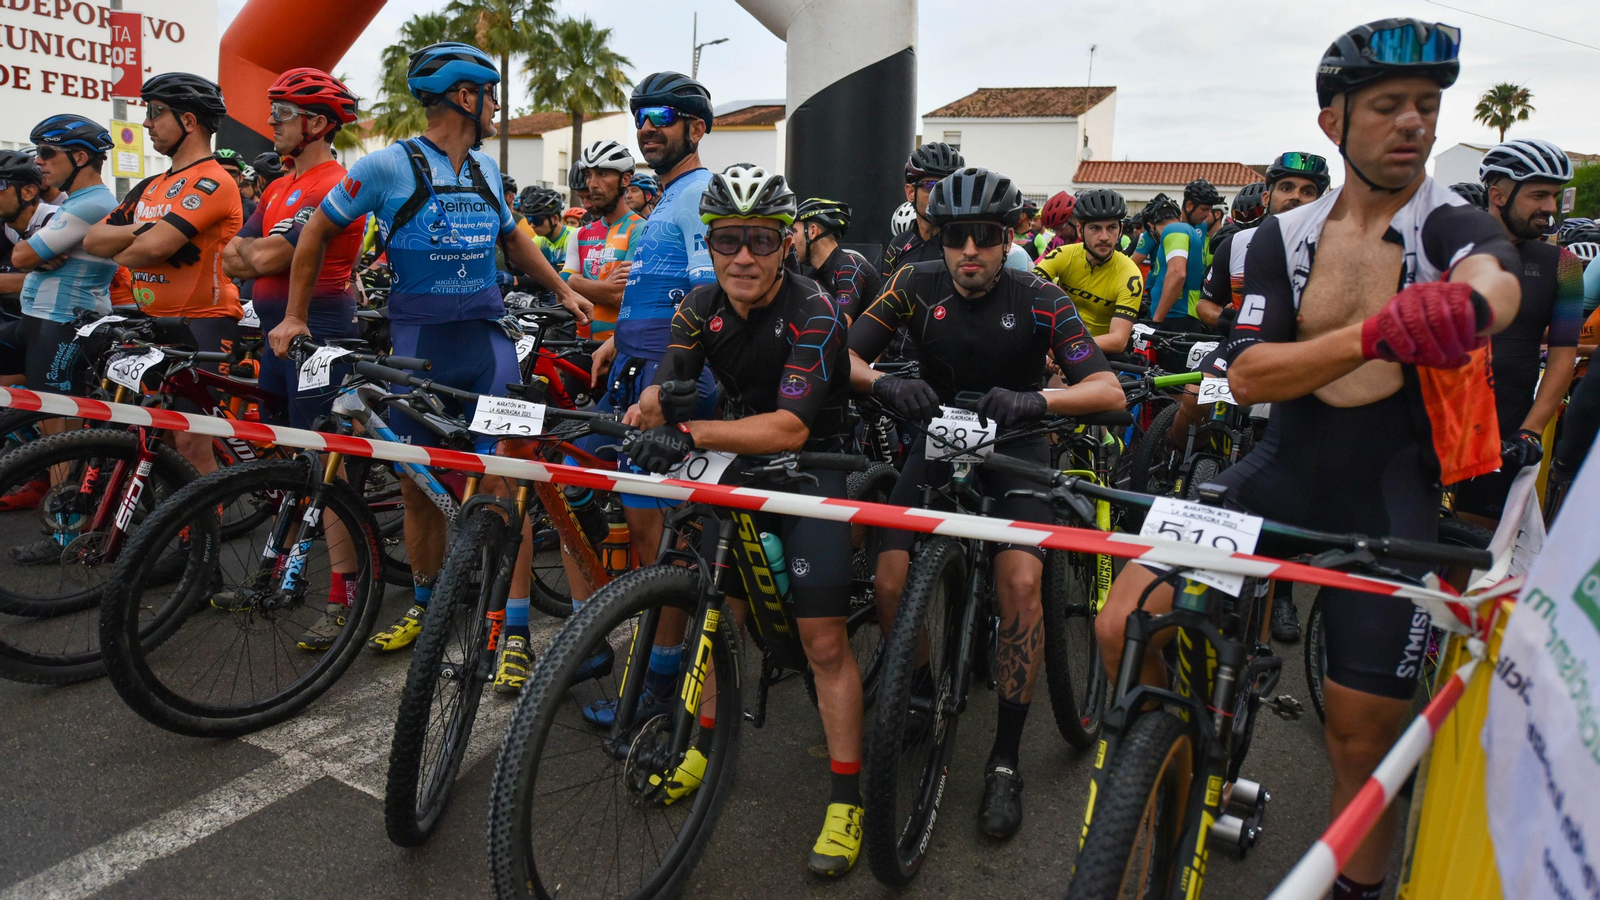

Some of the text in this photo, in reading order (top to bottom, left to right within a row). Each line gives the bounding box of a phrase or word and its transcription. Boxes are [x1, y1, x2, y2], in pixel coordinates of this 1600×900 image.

[800, 209, 826, 220] SCOTT
[429, 252, 484, 261] Grupo Solera
[1061, 283, 1116, 307] SCOTT
[302, 355, 330, 378] 404
[932, 425, 990, 450] 387
[281, 555, 307, 591] FOX
